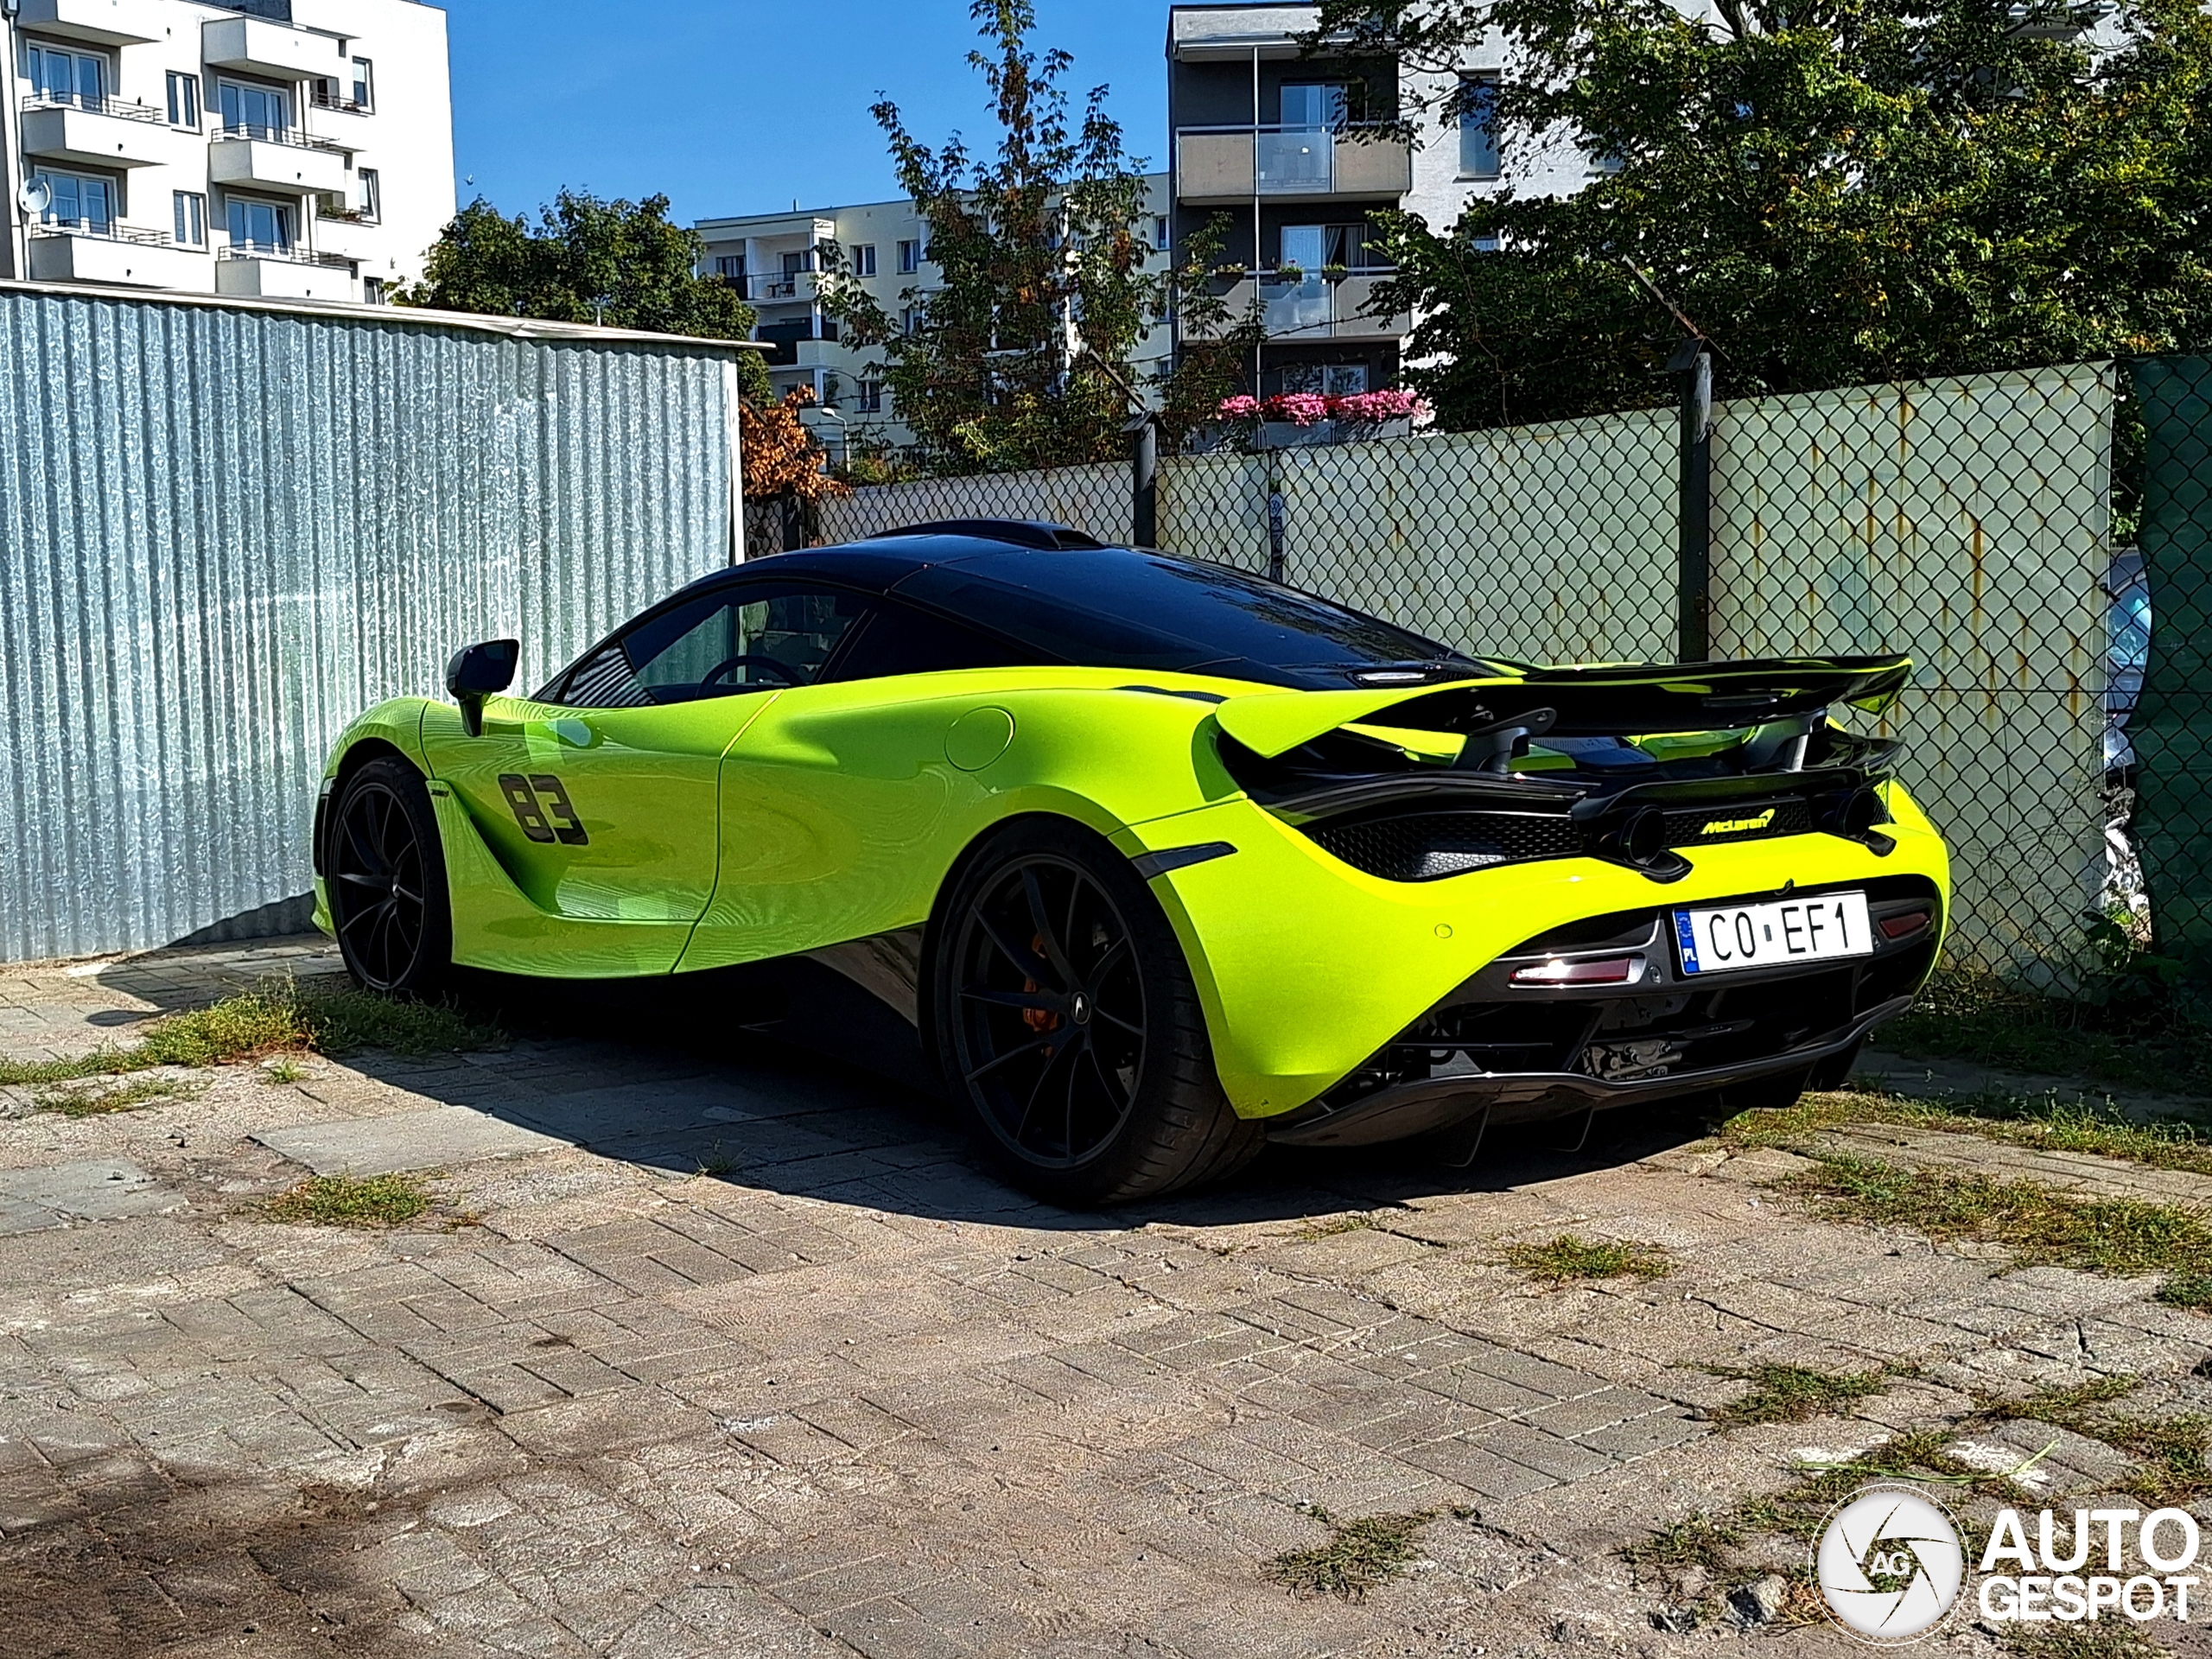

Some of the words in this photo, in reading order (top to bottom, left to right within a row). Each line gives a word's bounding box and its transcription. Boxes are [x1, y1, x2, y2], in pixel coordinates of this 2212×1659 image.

[498, 773, 589, 846] 83
[1700, 817, 1770, 835] McLaren
[1780, 902, 1848, 955] EF1
[1682, 948, 1697, 962] PL
